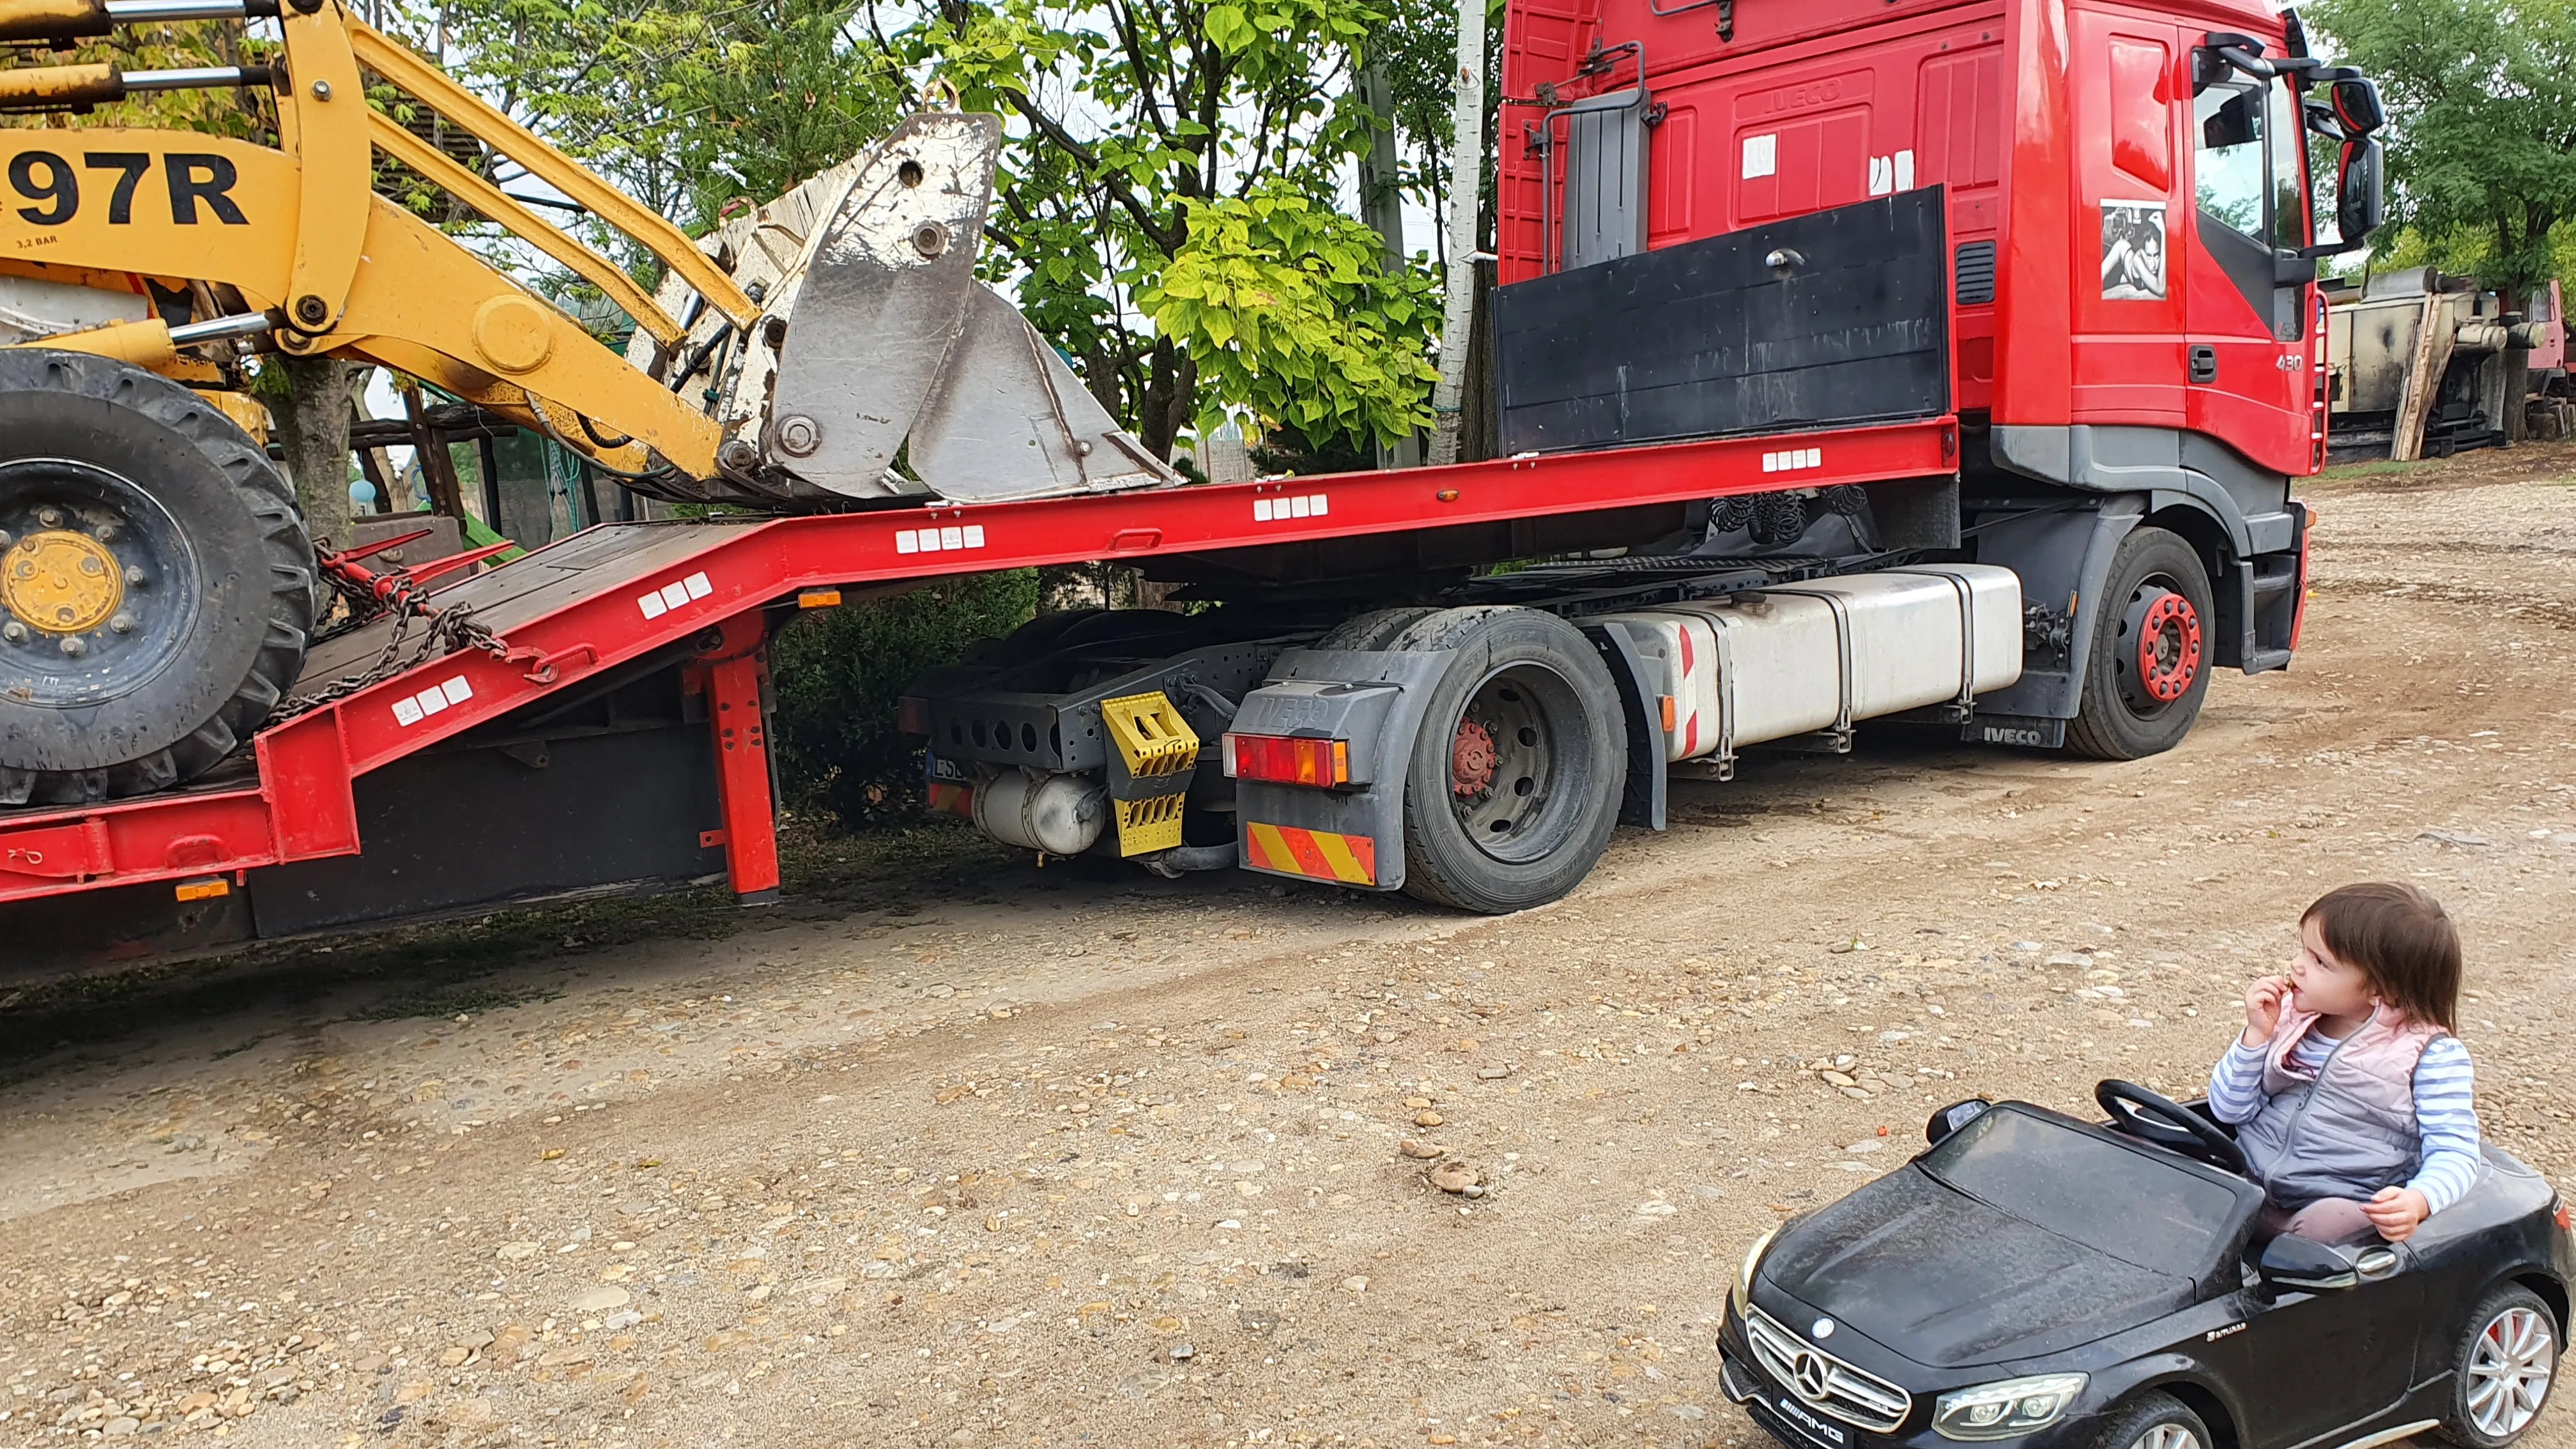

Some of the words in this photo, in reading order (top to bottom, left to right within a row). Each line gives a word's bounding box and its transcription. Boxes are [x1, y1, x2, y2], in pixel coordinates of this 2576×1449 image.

[1763, 77, 1841, 114] IVECO
[8, 150, 250, 226] 97R
[16, 240, 33, 250] 3,2
[35, 234, 58, 246] BAR
[2275, 354, 2303, 372] 430
[1984, 726, 2041, 745] IVECO
